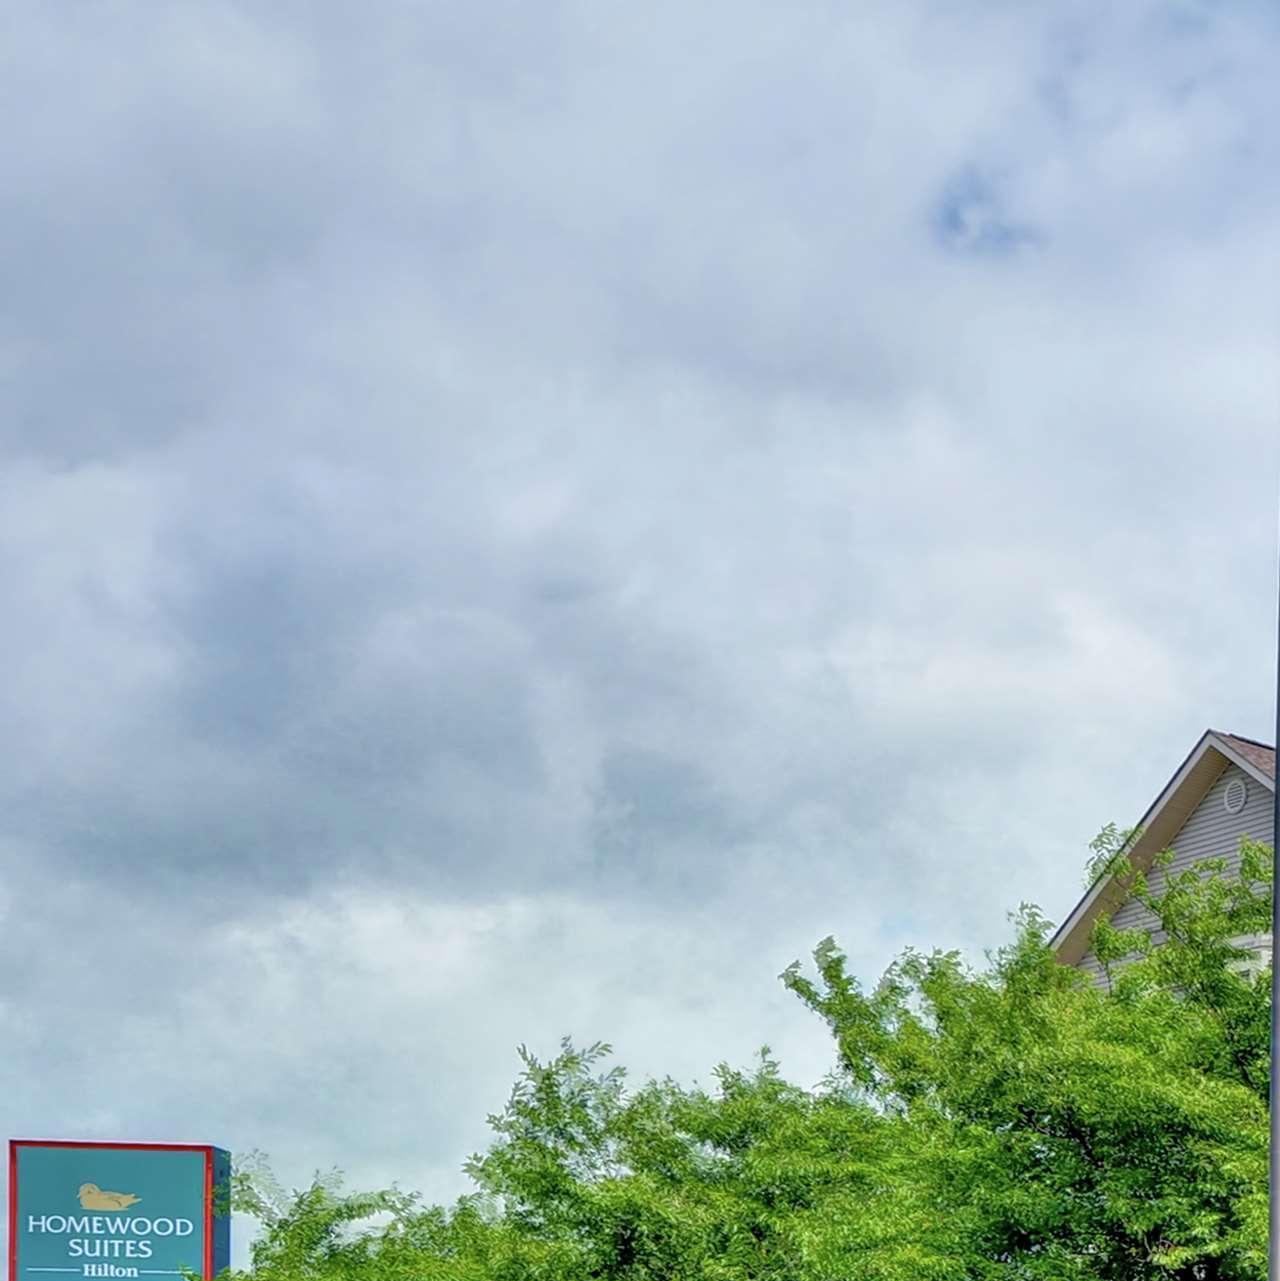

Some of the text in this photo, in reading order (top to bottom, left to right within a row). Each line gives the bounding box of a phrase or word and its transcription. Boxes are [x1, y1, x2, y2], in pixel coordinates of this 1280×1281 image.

[28, 1215, 194, 1236] HOMEWOOD
[68, 1238, 153, 1258] SUITES
[83, 1264, 139, 1278] Hilton
